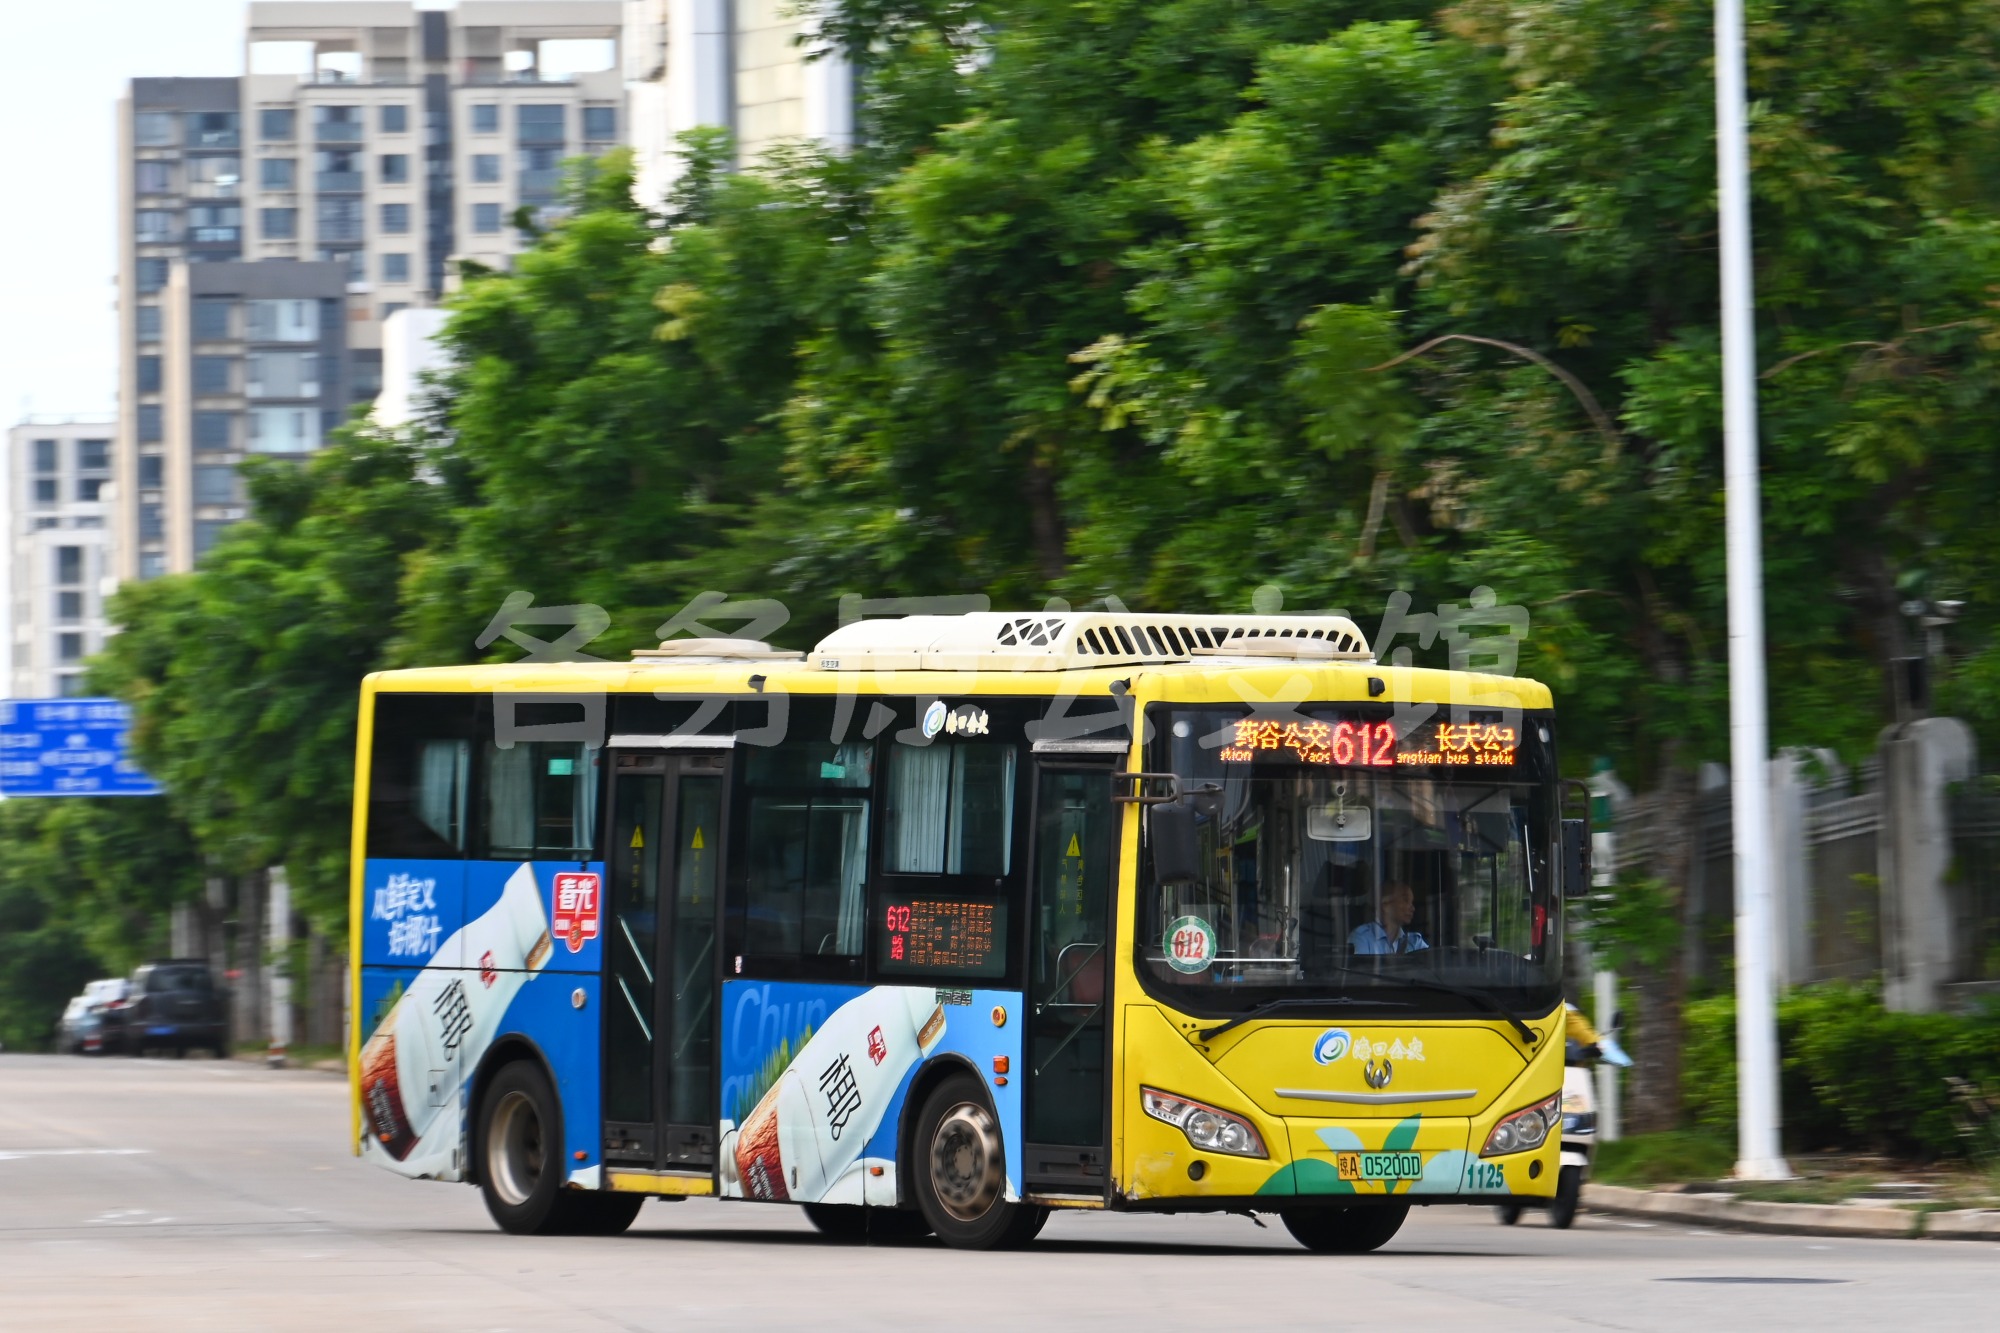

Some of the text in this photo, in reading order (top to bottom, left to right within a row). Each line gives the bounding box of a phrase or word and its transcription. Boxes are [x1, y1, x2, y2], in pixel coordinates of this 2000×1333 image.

[1234, 720, 1331, 750] 药谷公交
[1332, 722, 1395, 765] 612
[1446, 751, 1469, 764] bus
[887, 906, 910, 931] 612
[1174, 930, 1204, 958] 612
[1364, 1156, 1420, 1176] 05200D
[1467, 1163, 1504, 1189] 1125
